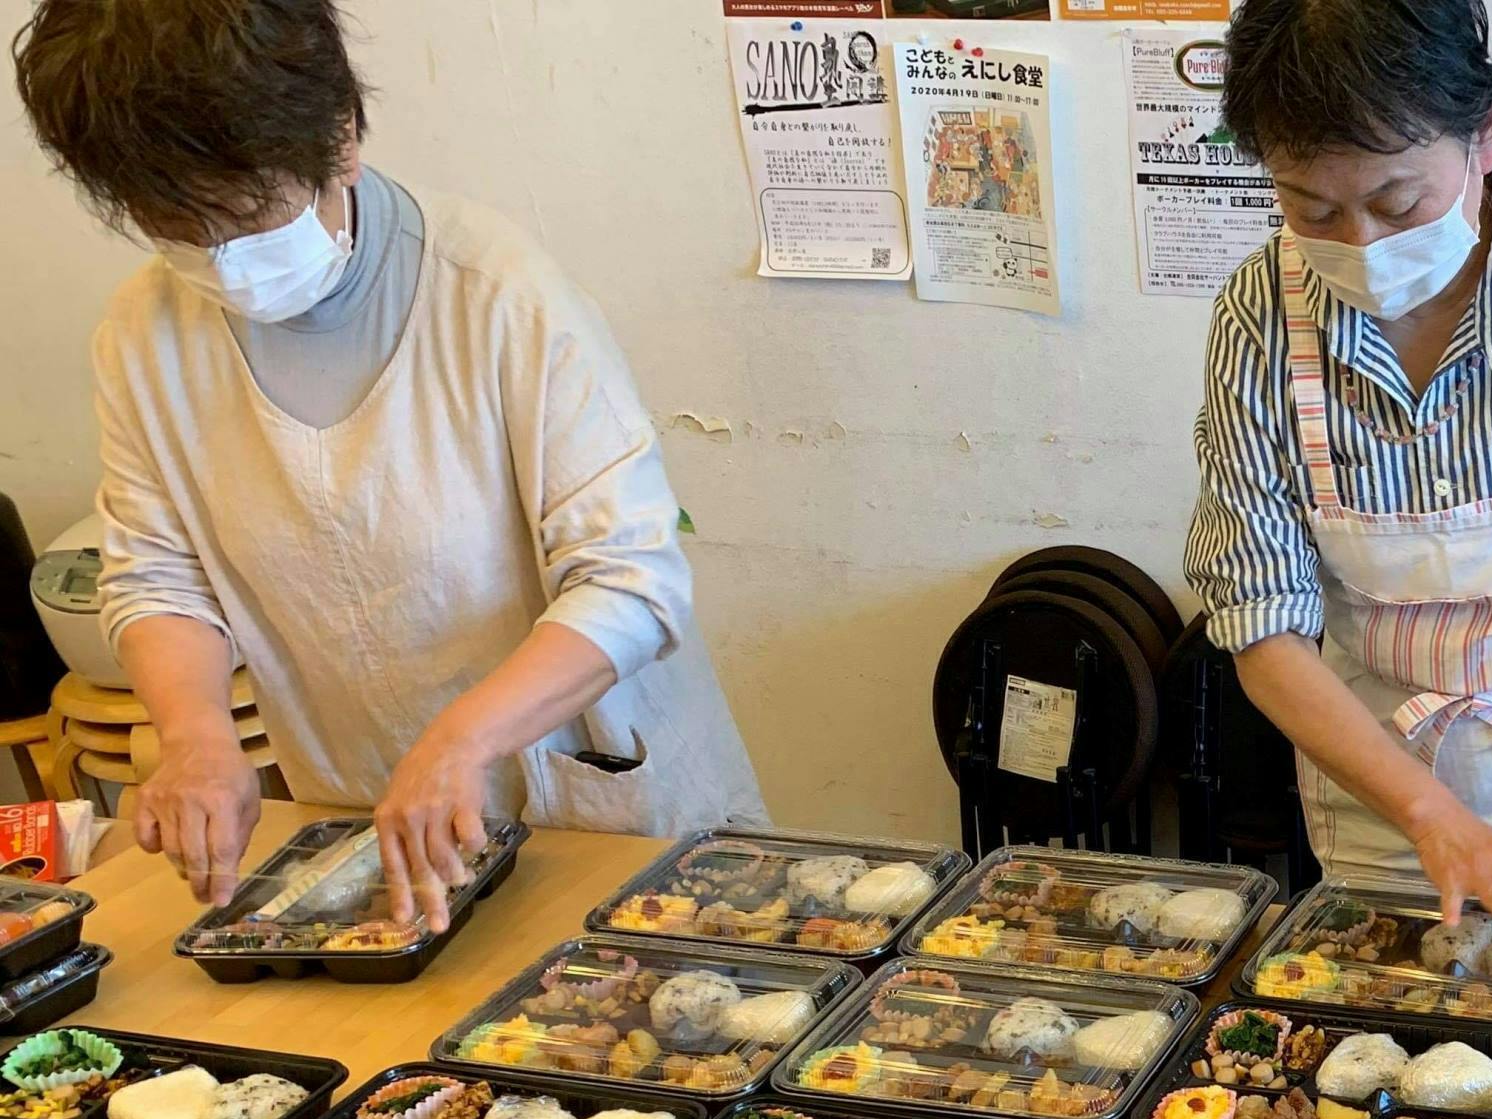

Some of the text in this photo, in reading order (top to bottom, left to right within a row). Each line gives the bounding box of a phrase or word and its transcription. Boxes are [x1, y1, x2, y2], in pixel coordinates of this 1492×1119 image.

[905, 49, 955, 65] こどもと
[746, 41, 818, 101] SANO
[906, 65, 957, 80] みんなの
[961, 59, 1044, 88] えにし食堂
[1187, 59, 1209, 73] Pure
[911, 86, 979, 98] 2020年4月19日
[1138, 142, 1200, 164] TEXAS
